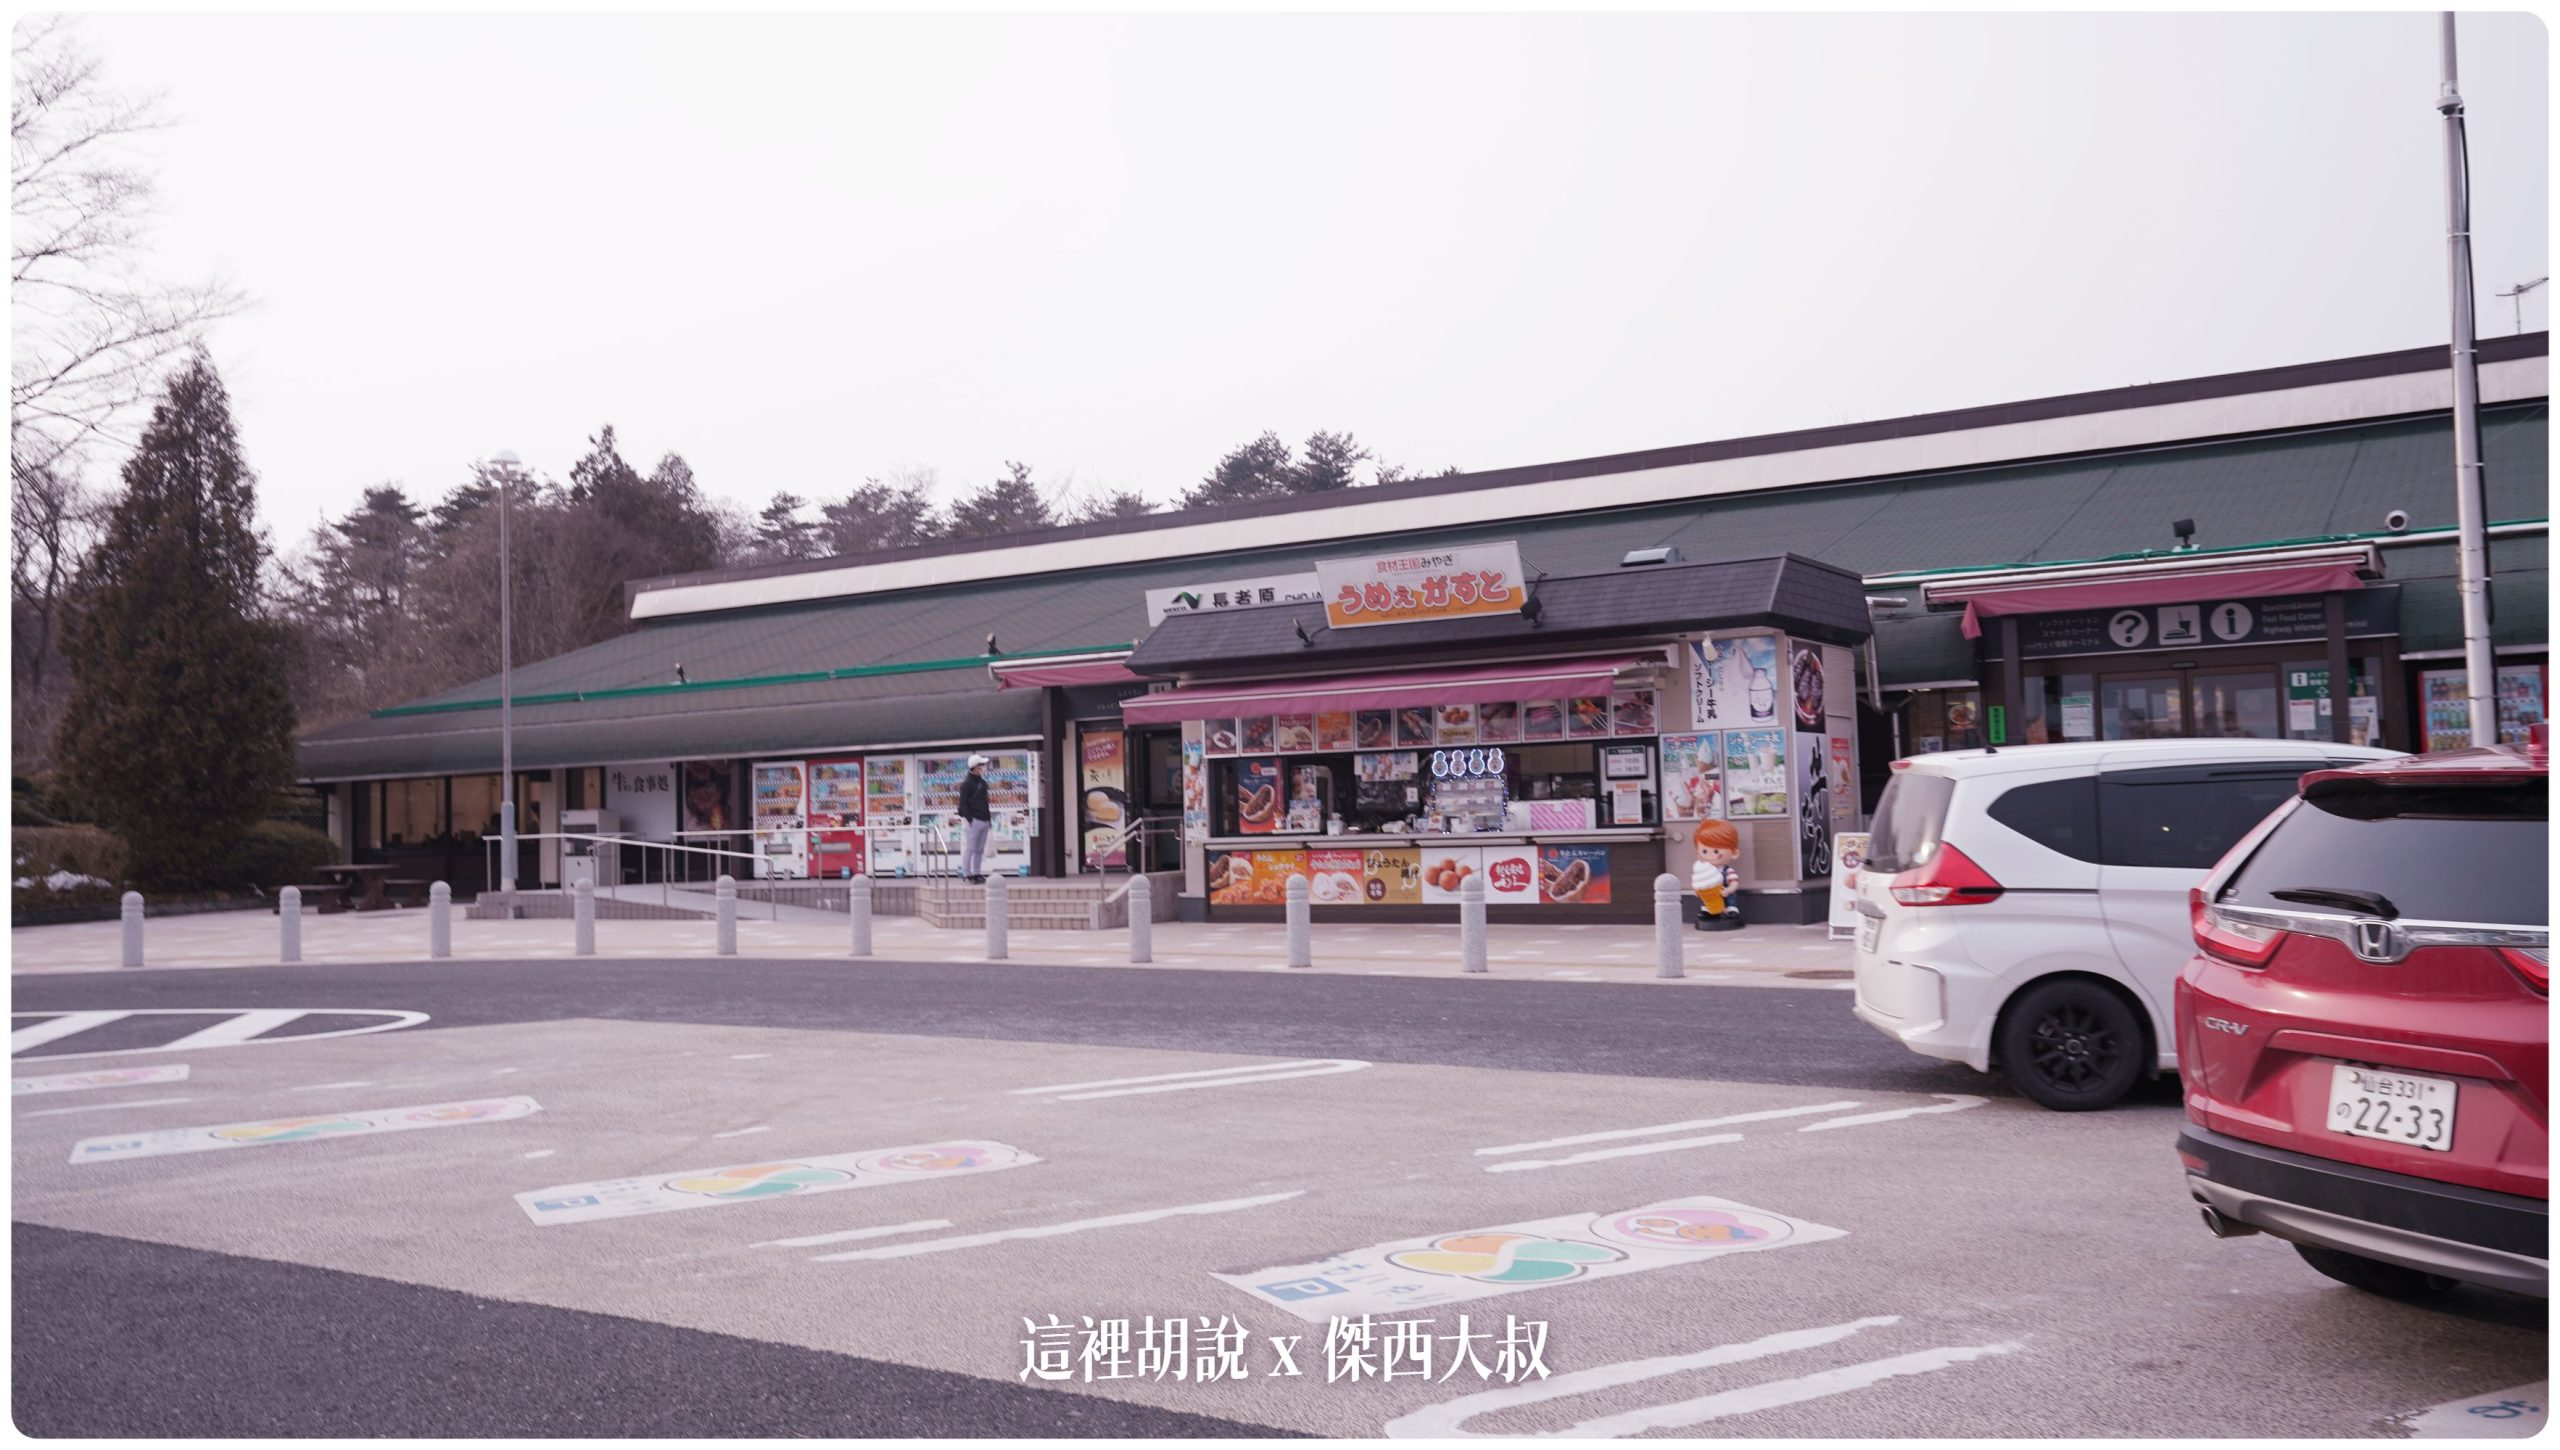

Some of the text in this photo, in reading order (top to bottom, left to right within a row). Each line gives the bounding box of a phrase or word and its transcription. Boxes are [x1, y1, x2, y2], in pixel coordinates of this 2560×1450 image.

[1376, 554, 1454, 573] 食材王国みやぎ
[2294, 623, 2327, 631] Informati
[2204, 1016, 2249, 1036] CR-V
[2354, 1097, 2444, 1142] 22-33
